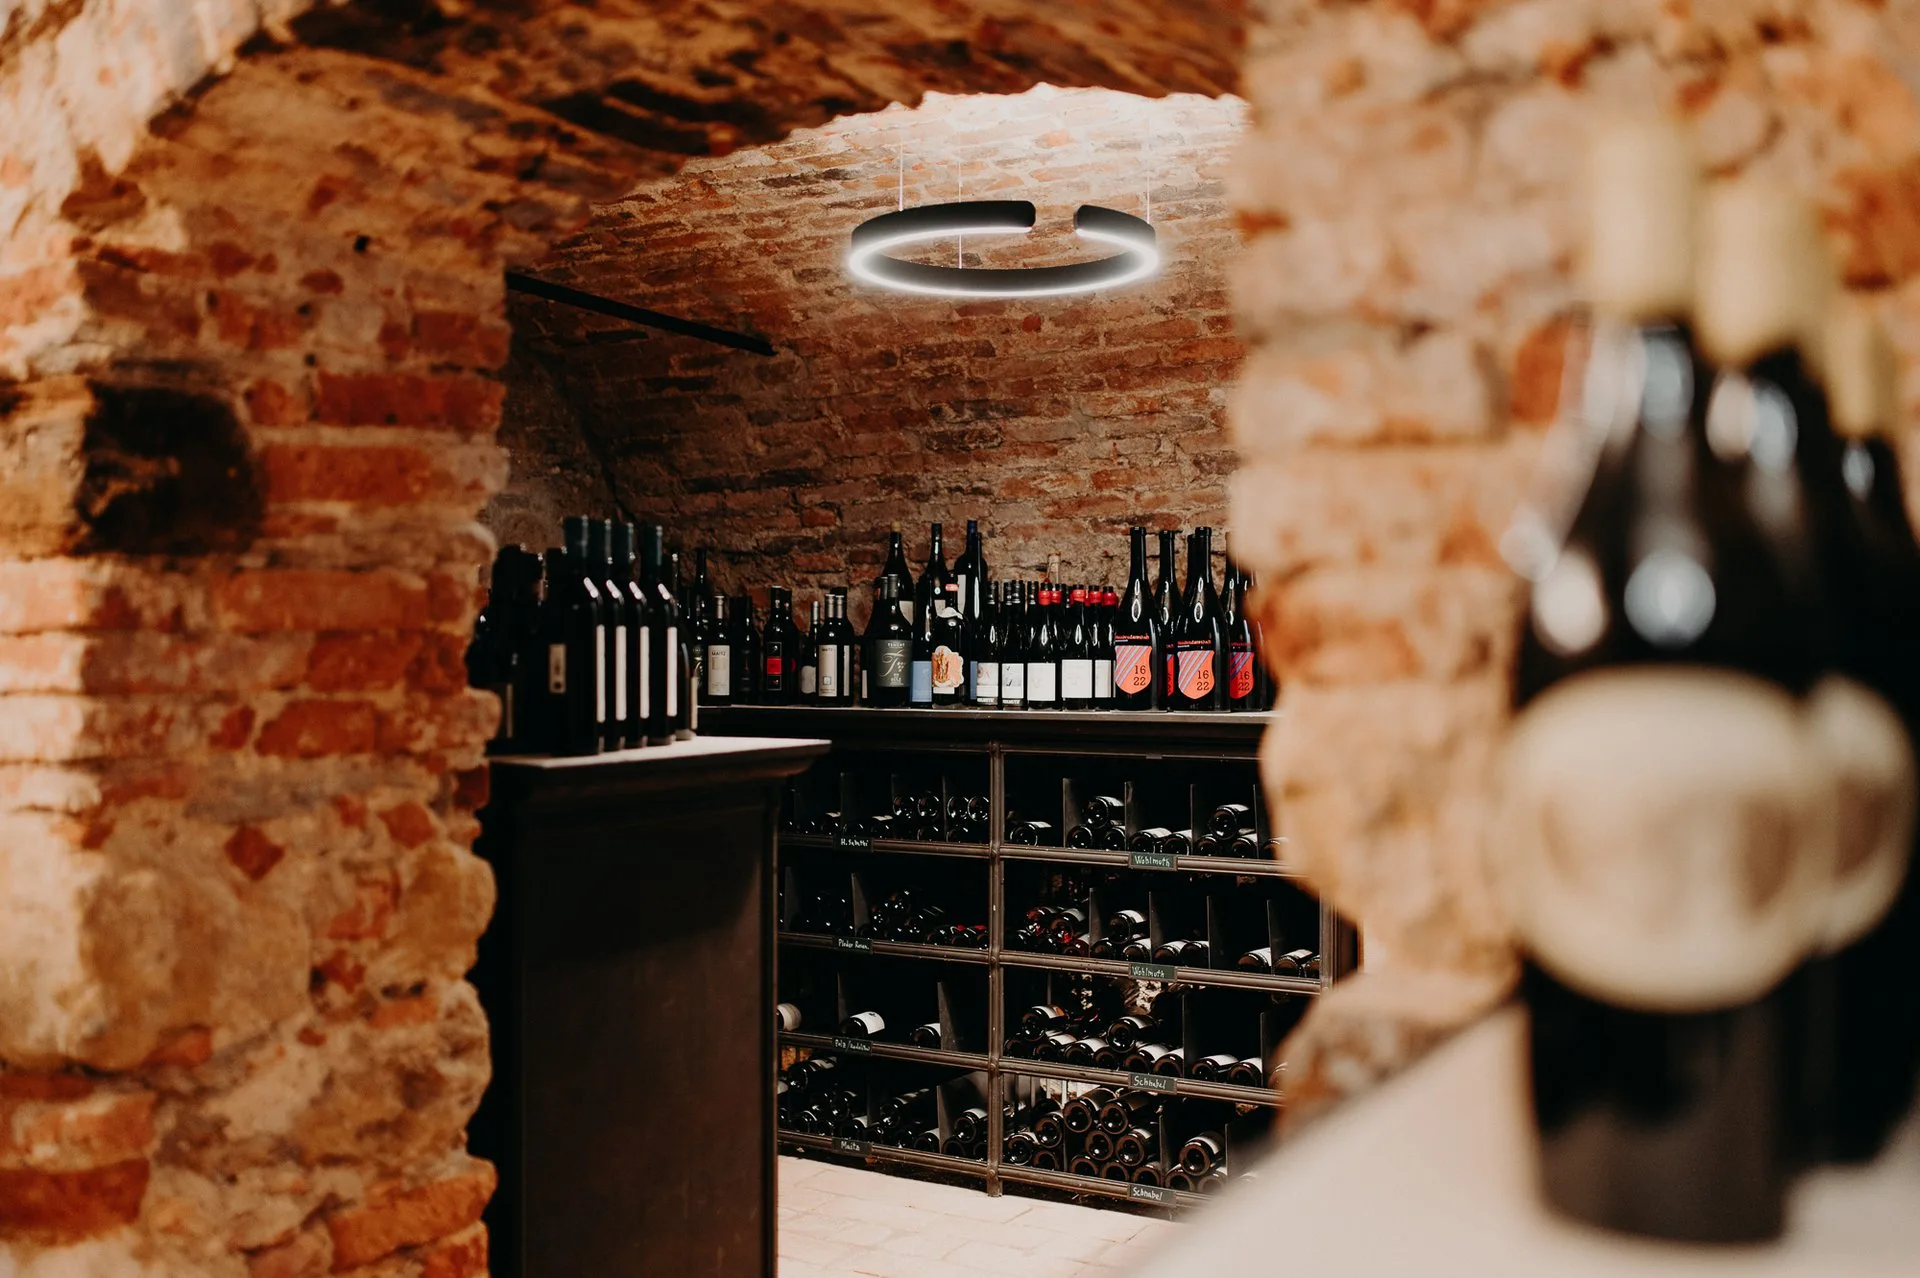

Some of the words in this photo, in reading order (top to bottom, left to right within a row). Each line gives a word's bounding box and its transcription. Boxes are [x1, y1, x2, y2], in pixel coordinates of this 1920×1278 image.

[1134, 665, 1146, 674] 16
[1197, 670, 1209, 679] 16
[1240, 671, 1250, 680] 16
[1133, 677, 1146, 686] 22
[1196, 682, 1209, 691] 22
[1238, 682, 1250, 691] 22
[1134, 855, 1170, 867] Wohlmuth
[1133, 1075, 1167, 1090] Schnabel
[1132, 1186, 1164, 1201] Schnabel
